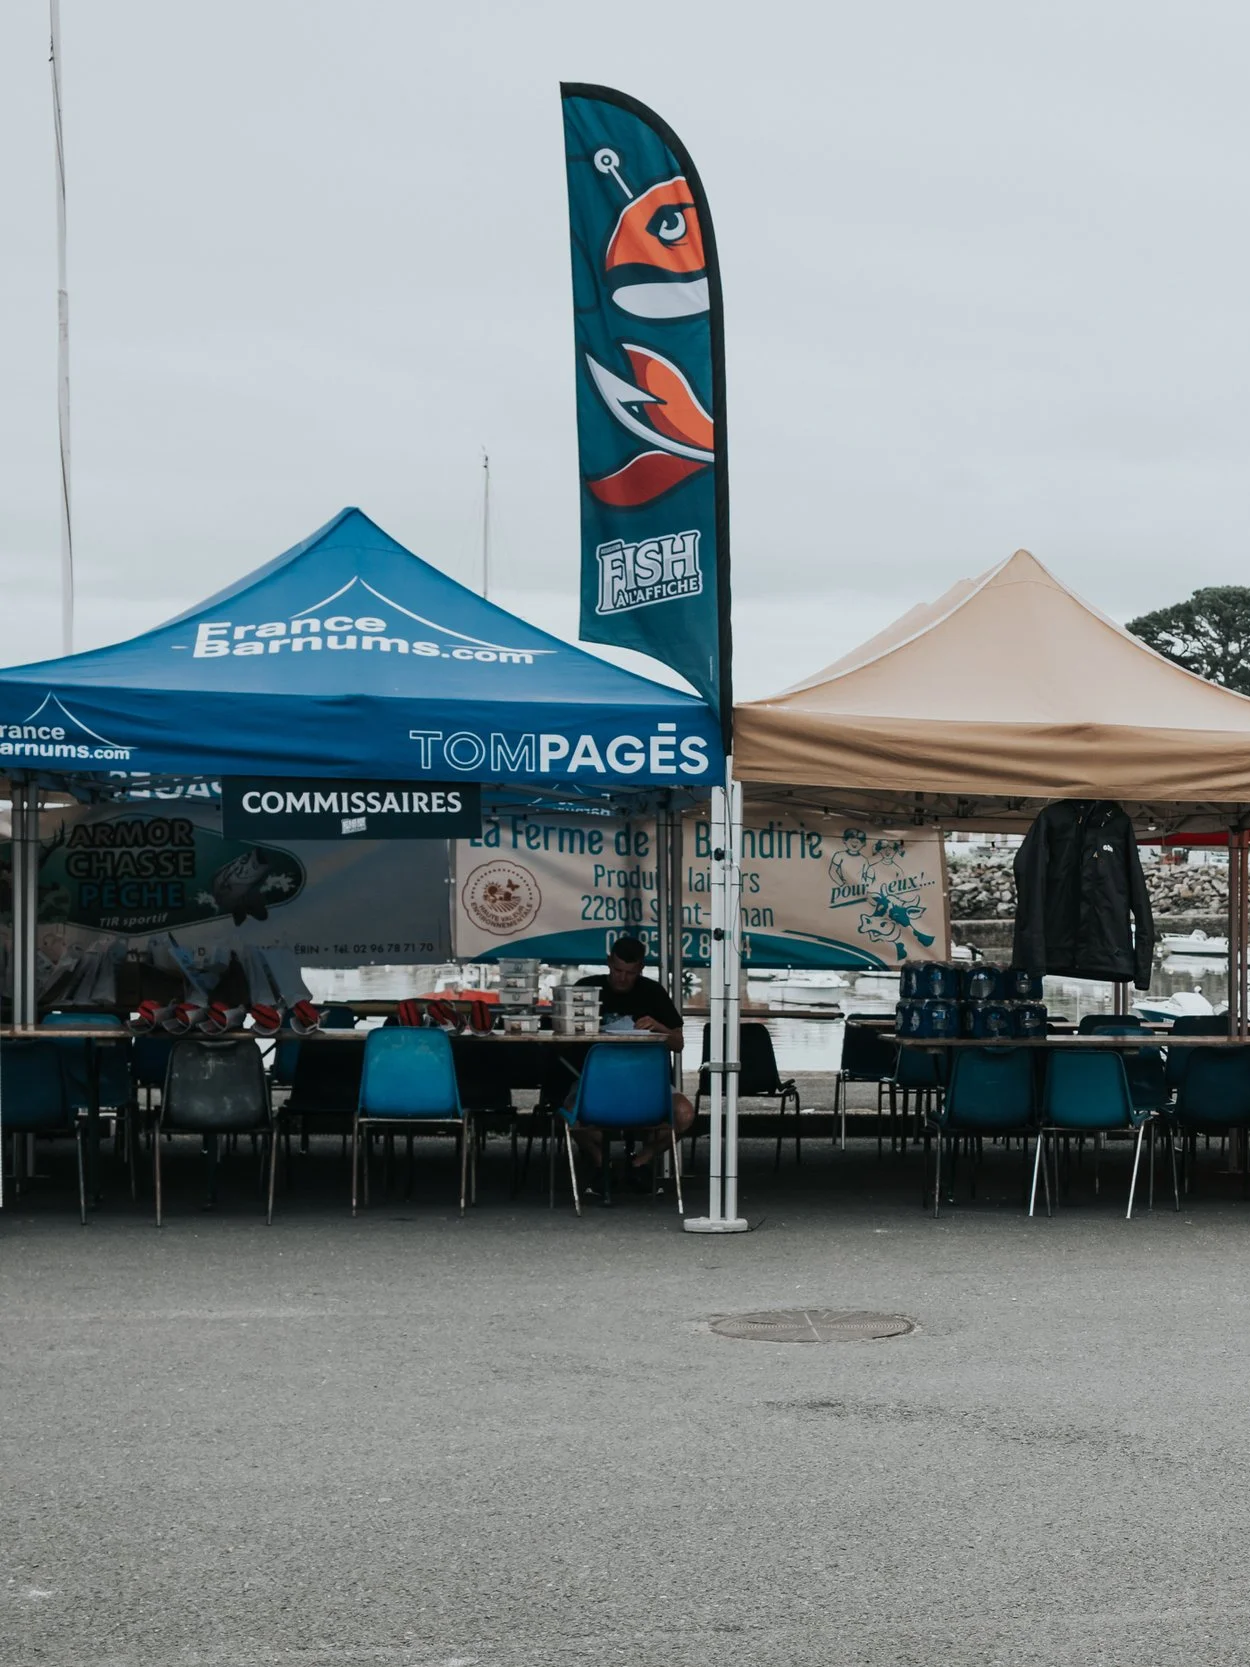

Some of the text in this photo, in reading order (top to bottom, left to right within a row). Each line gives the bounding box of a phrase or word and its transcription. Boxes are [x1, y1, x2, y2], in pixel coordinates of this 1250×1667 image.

[598, 532, 700, 611] FISH
[629, 578, 699, 605] L'AFFICHE
[197, 616, 387, 641] France
[193, 633, 534, 665] Barnums.com
[0, 724, 66, 741] rance
[0, 742, 131, 760] arnums.com
[241, 791, 462, 814] COMMISSAIRES
[66, 818, 194, 848] ARMOR
[511, 815, 603, 856] Ferme
[614, 822, 649, 857] de
[66, 850, 195, 878] CHASSE
[830, 884, 869, 904] pour
[100, 912, 169, 928] TIR sportif
[479, 905, 499, 921] HAUTE
[581, 895, 643, 922] 22800
[353, 944, 367, 954] 02
[370, 943, 385, 954] 96
[387, 943, 401, 953] 78
[403, 943, 416, 953] 71
[419, 942, 434, 953] 70
